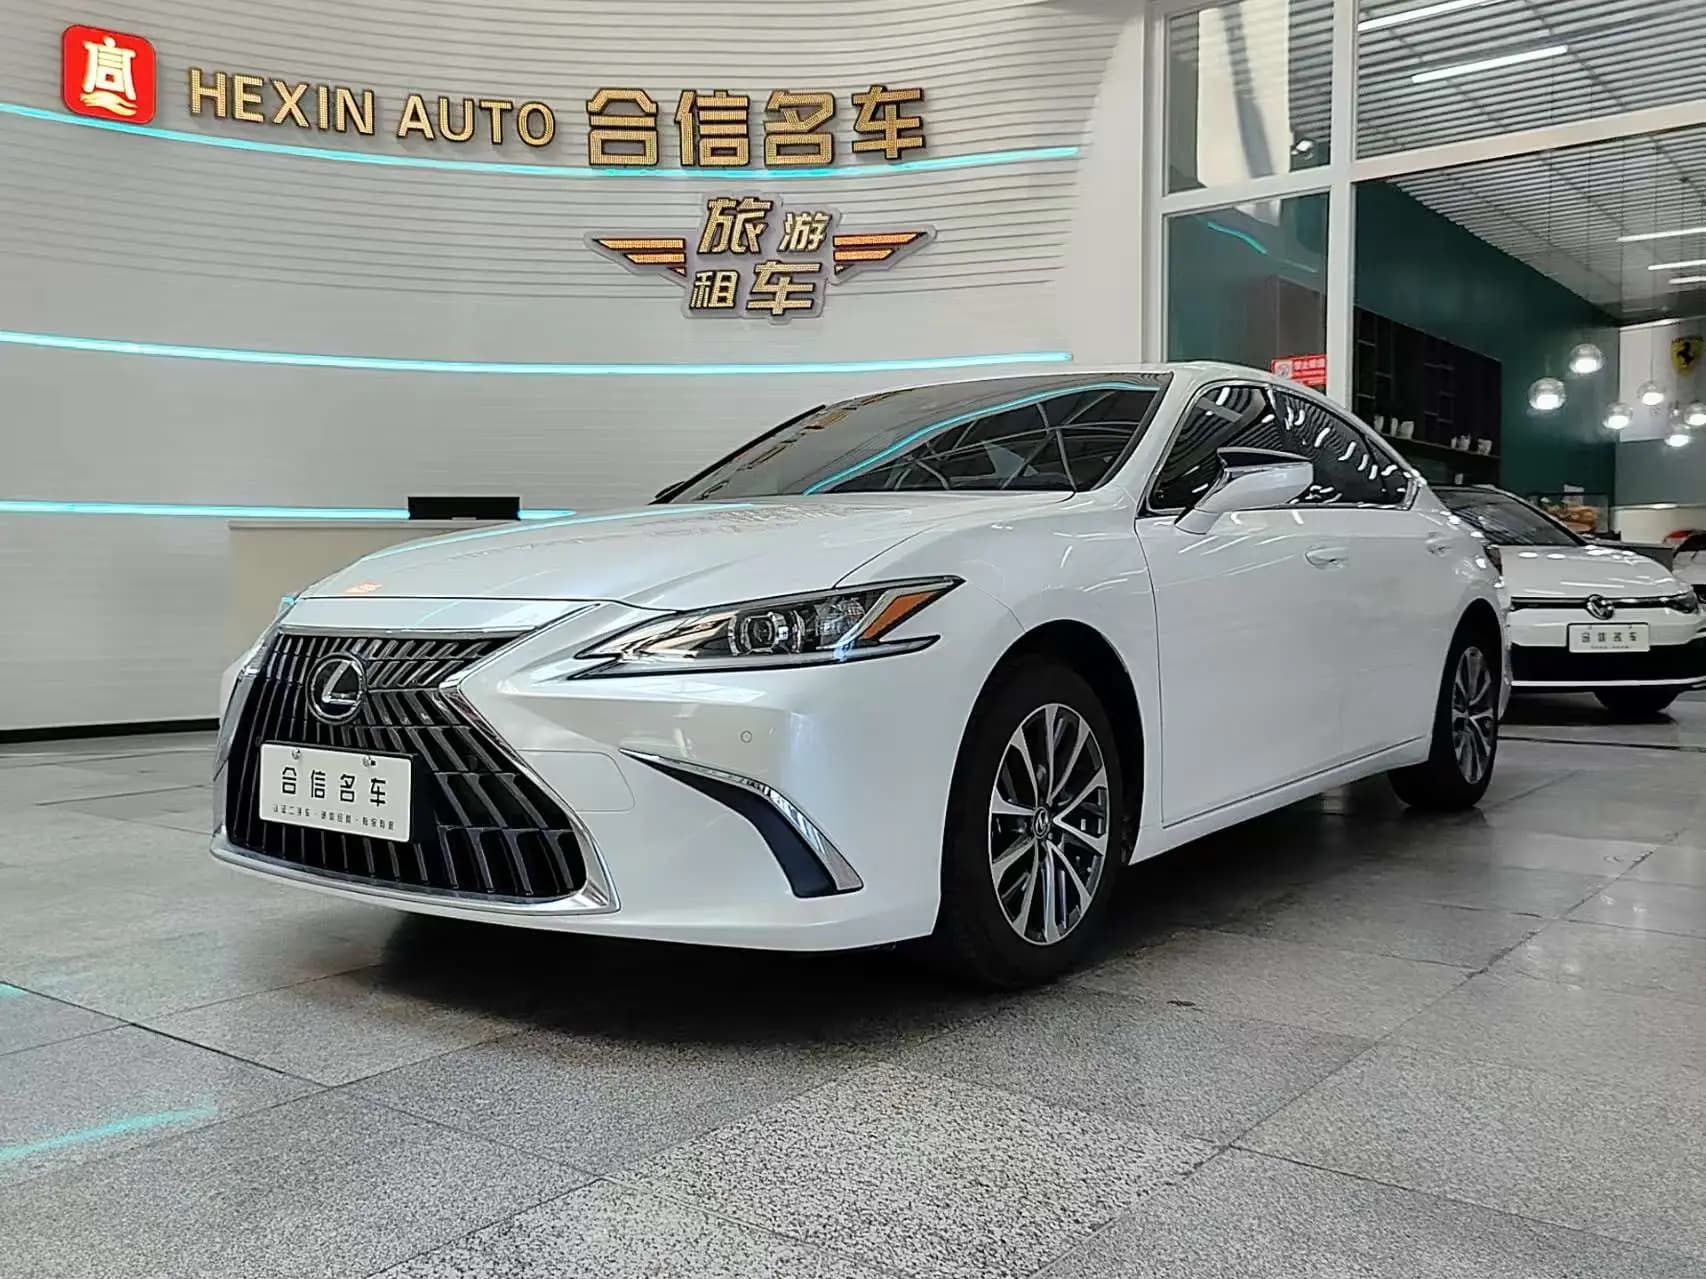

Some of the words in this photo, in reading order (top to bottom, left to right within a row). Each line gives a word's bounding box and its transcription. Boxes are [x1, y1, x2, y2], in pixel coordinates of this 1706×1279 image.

[188, 67, 376, 136] HEXIN
[396, 94, 556, 147] AUTO
[586, 85, 925, 167] 合信名车
[696, 197, 833, 254] 旅游
[688, 260, 822, 315] 租车
[282, 766, 386, 807] 合信名车
